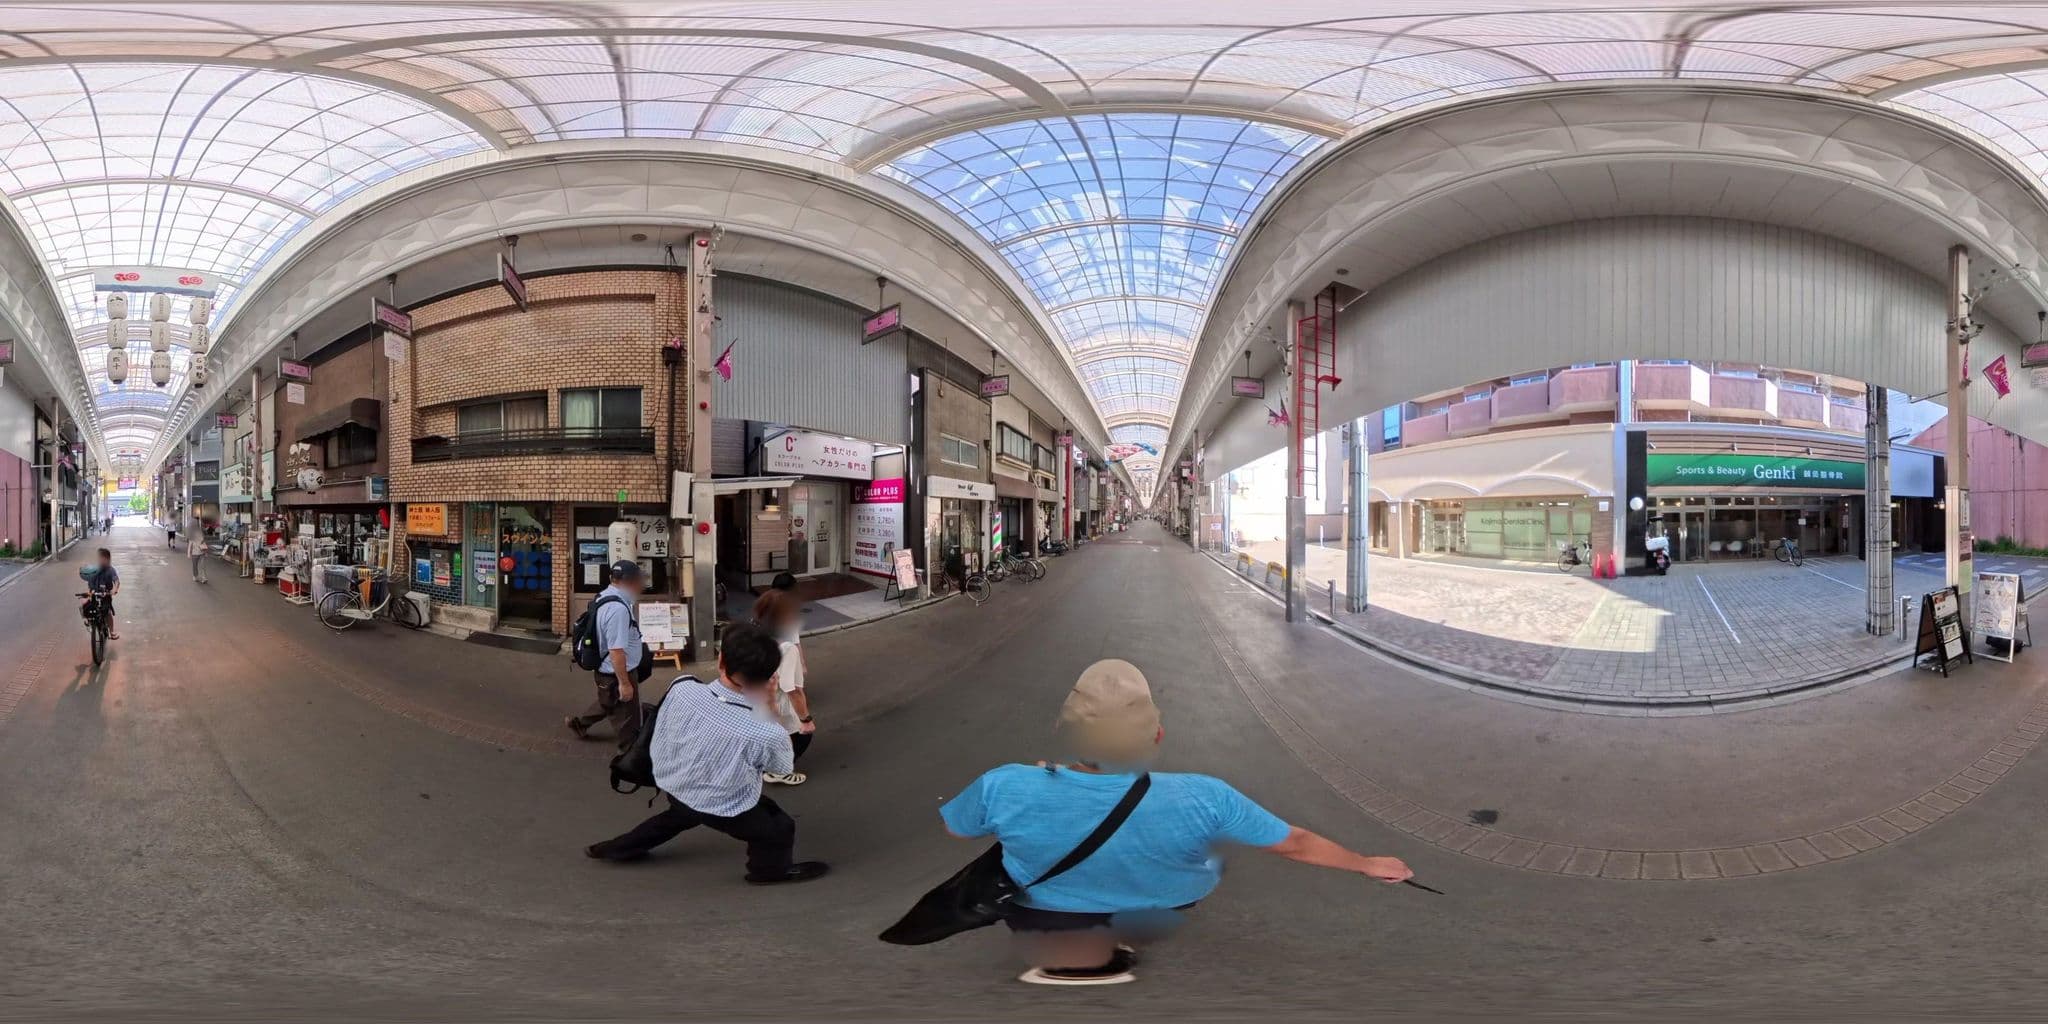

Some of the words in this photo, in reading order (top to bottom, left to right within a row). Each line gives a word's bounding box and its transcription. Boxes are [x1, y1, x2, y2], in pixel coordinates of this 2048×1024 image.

[823, 446, 858, 457] 女性だけの
[812, 459, 868, 472] ヘアカラー専門店
[1676, 466, 1706, 476] Sports
[1707, 466, 1715, 474] &
[1717, 466, 1746, 476] Beauty
[1753, 464, 1796, 480] Genki
[882, 486, 899, 495] PLUS
